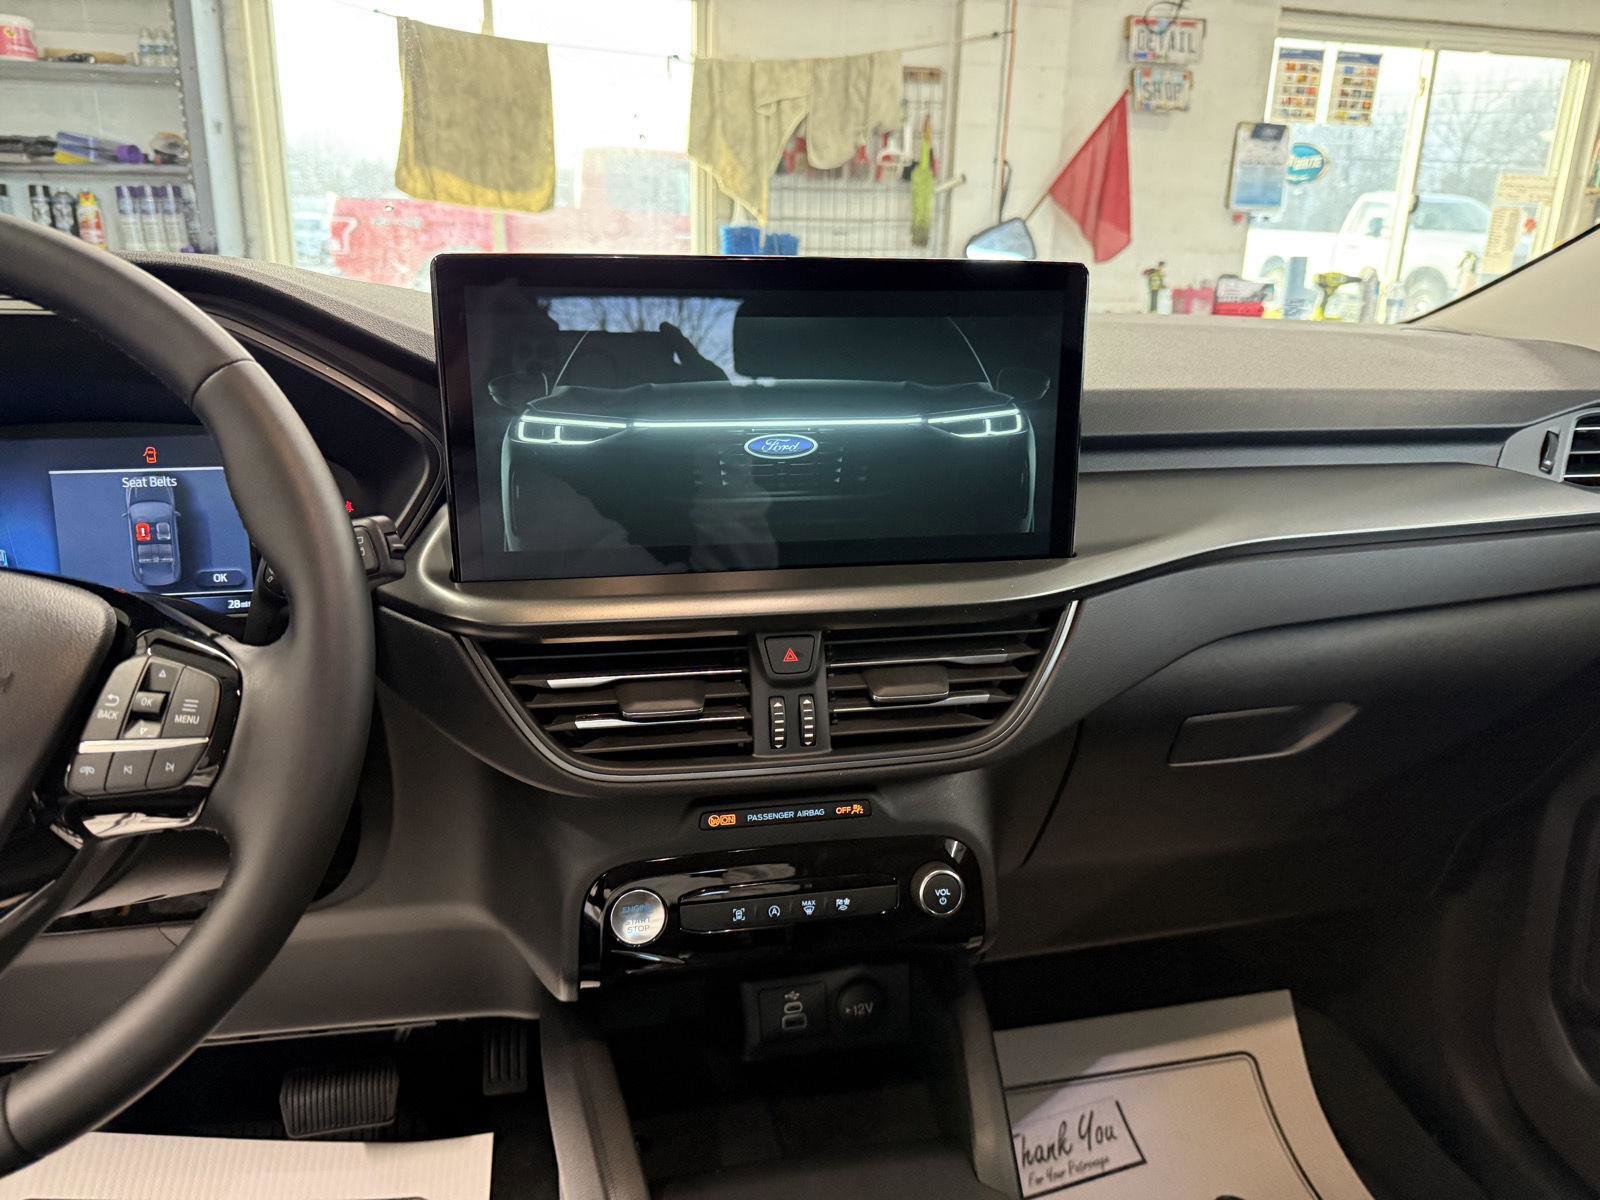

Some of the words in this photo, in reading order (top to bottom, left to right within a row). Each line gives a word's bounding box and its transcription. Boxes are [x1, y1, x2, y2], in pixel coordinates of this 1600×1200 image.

[762, 438, 801, 453] Ford
[122, 477, 148, 488] Seat
[149, 475, 177, 488] Belts
[213, 573, 228, 583] OK
[140, 697, 153, 707] OK
[97, 709, 118, 720] BACK
[174, 714, 200, 725] MENU
[747, 810, 795, 822] PASSENGER
[796, 808, 825, 818] AIRBAG
[835, 806, 851, 815] OFF
[934, 888, 951, 897] VOL
[801, 899, 816, 907] MAX
[627, 924, 650, 934] STOP
[1012, 1119, 1074, 1169] hank
[1078, 1109, 1118, 1152] You
